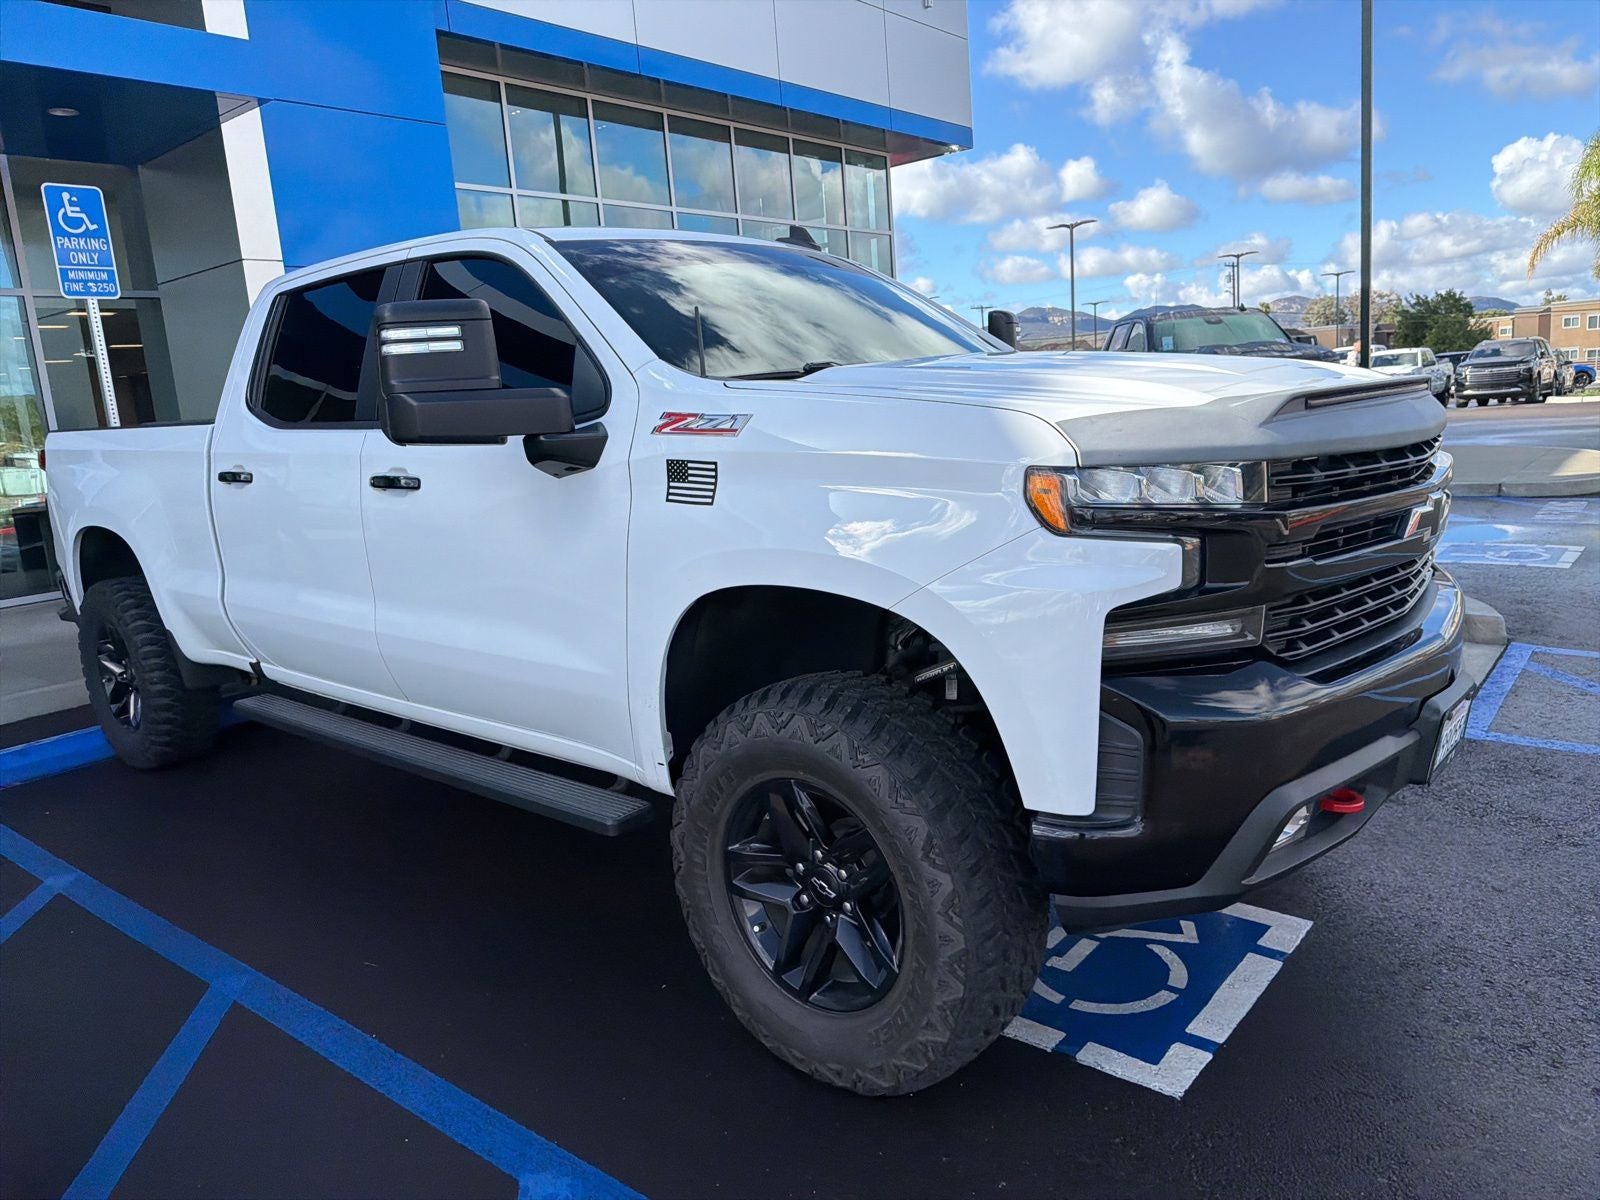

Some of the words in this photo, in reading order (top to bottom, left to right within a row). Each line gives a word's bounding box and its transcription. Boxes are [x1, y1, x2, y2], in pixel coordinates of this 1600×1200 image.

[56, 236, 107, 251] PARKING
[70, 251, 99, 265] ONLY
[68, 270, 108, 281] MINIMUM
[64, 282, 85, 292] FINE
[90, 282, 116, 293] $250
[651, 411, 754, 437] Z71
